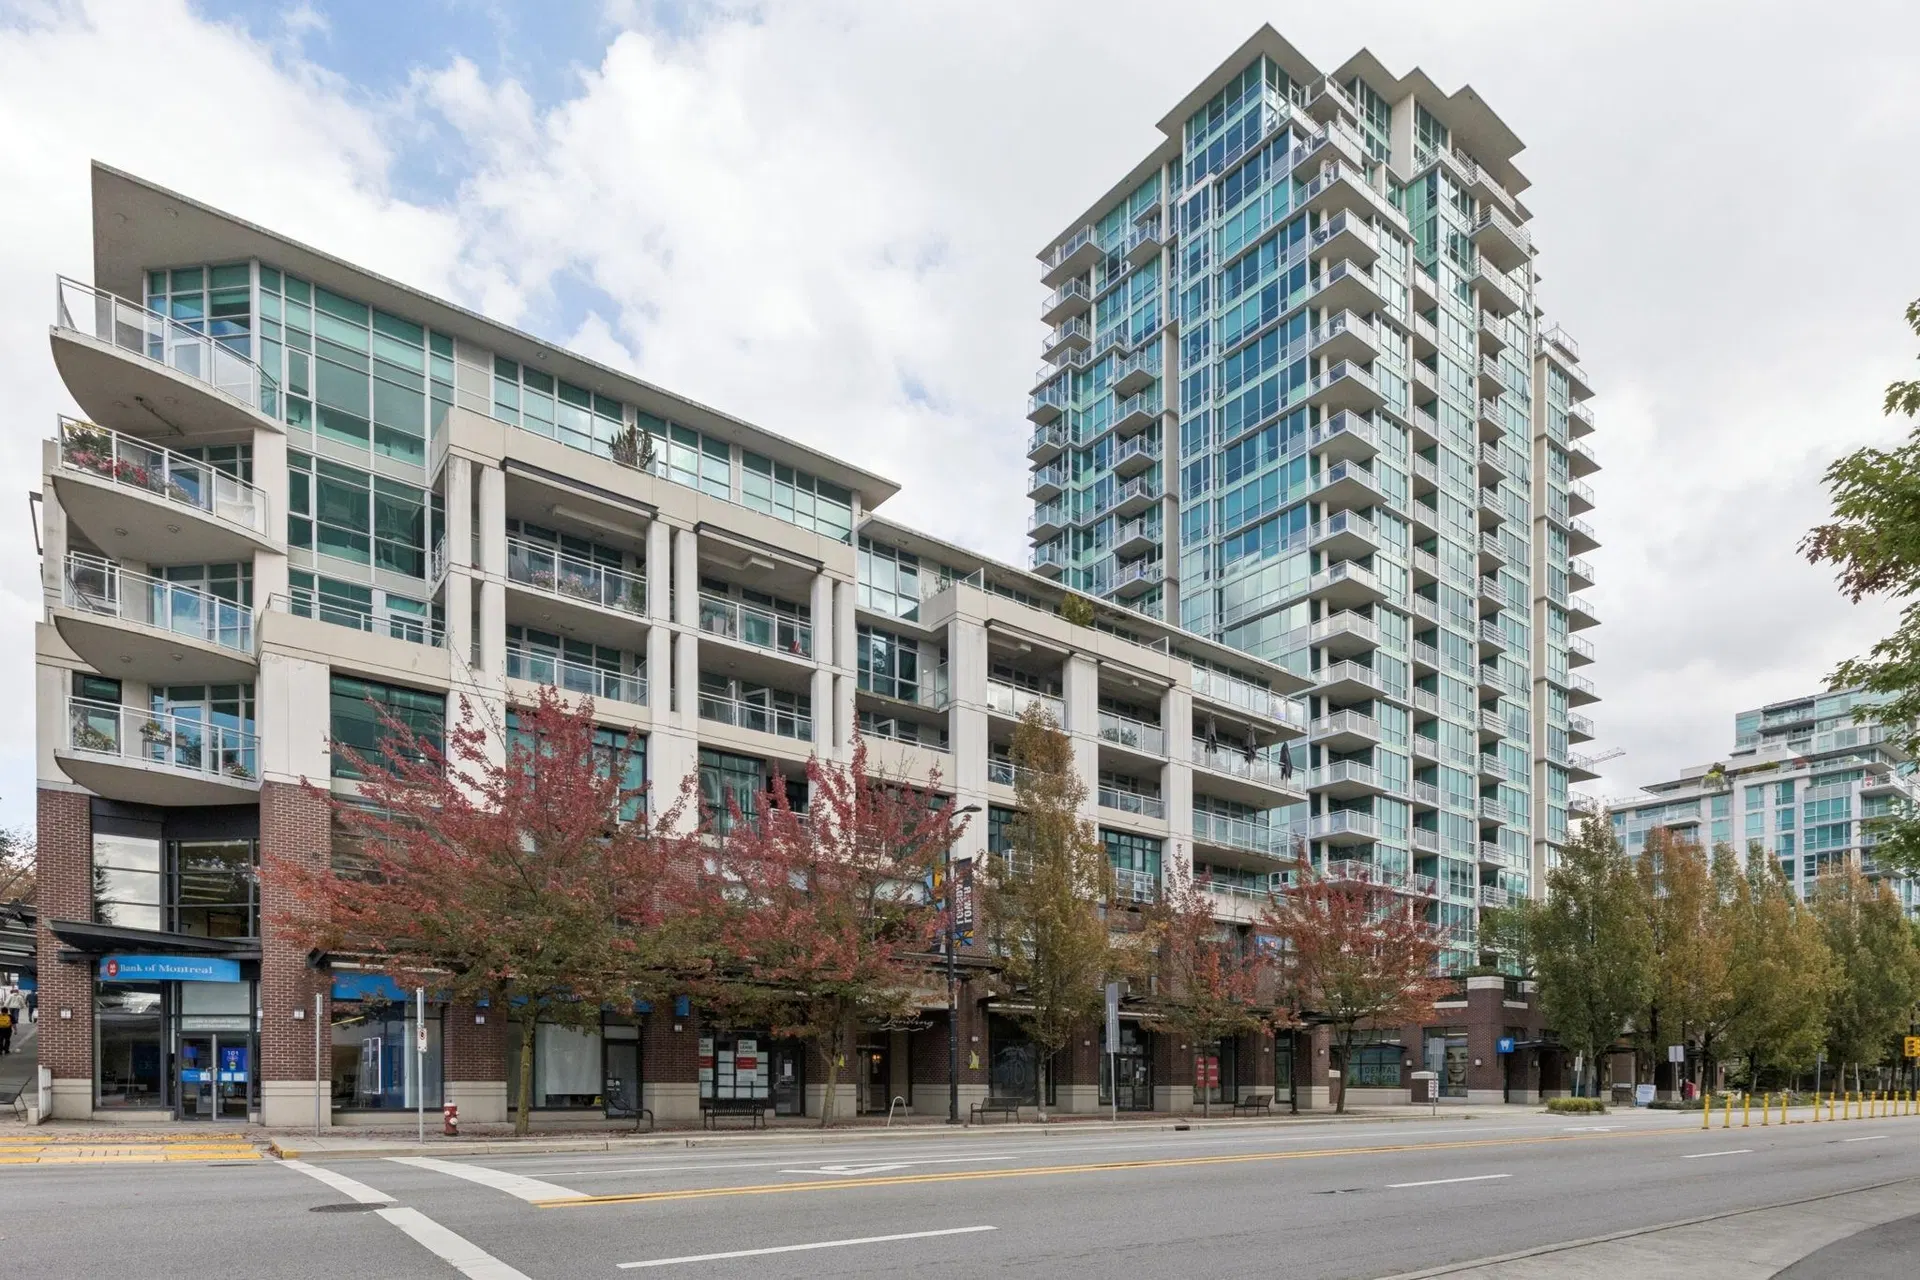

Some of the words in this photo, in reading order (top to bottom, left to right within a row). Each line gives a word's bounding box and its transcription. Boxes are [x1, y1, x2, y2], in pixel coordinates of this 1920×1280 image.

[120, 964, 142, 972] Bank
[145, 963, 156, 972] of
[159, 964, 213, 974] Montreal
[881, 1016, 934, 1029] Landing
[1364, 1066, 1397, 1074] DENTAL
